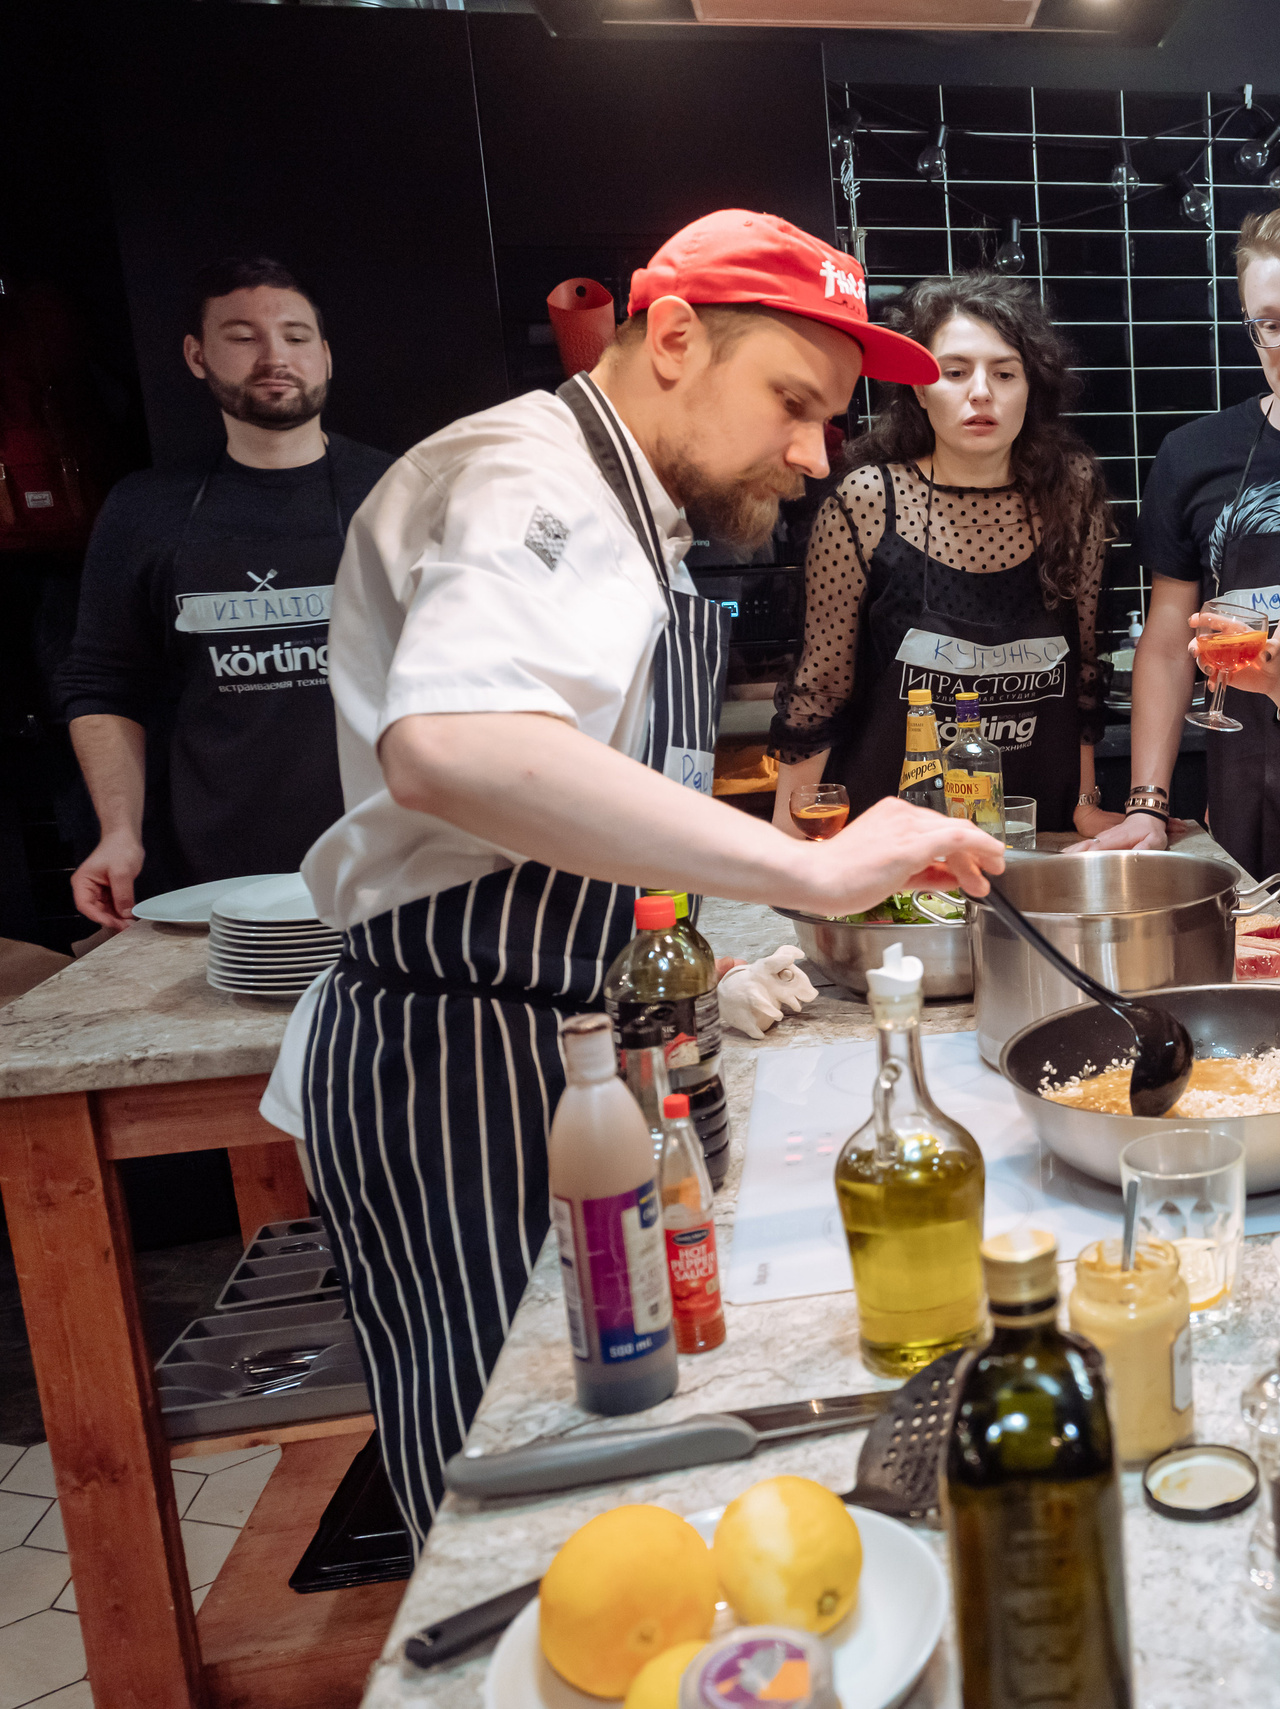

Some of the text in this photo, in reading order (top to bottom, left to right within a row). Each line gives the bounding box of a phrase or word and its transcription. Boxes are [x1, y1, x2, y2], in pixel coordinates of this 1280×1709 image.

[213, 593, 324, 621] VITALIO
[972, 667, 1061, 695] СТОЛОВ
[671, 1252, 716, 1272] PEPPER
[678, 1243, 707, 1261] HOT
[673, 1266, 714, 1282] SAUCE
